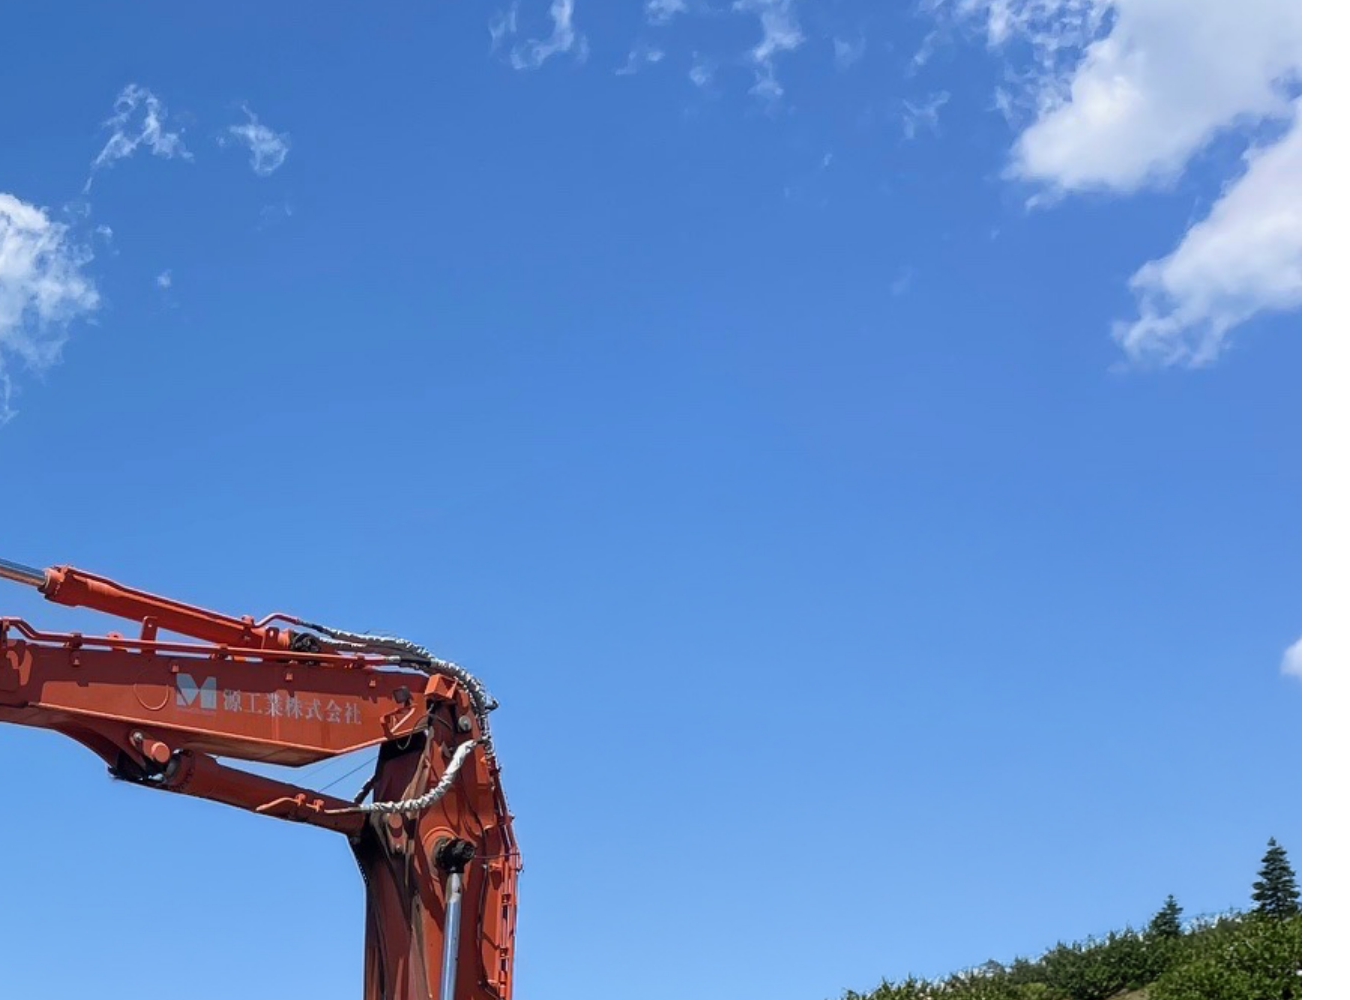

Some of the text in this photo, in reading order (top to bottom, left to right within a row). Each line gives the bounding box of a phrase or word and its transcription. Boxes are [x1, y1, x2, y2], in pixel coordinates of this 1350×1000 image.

[223, 689, 362, 725] 源工業株式会社
